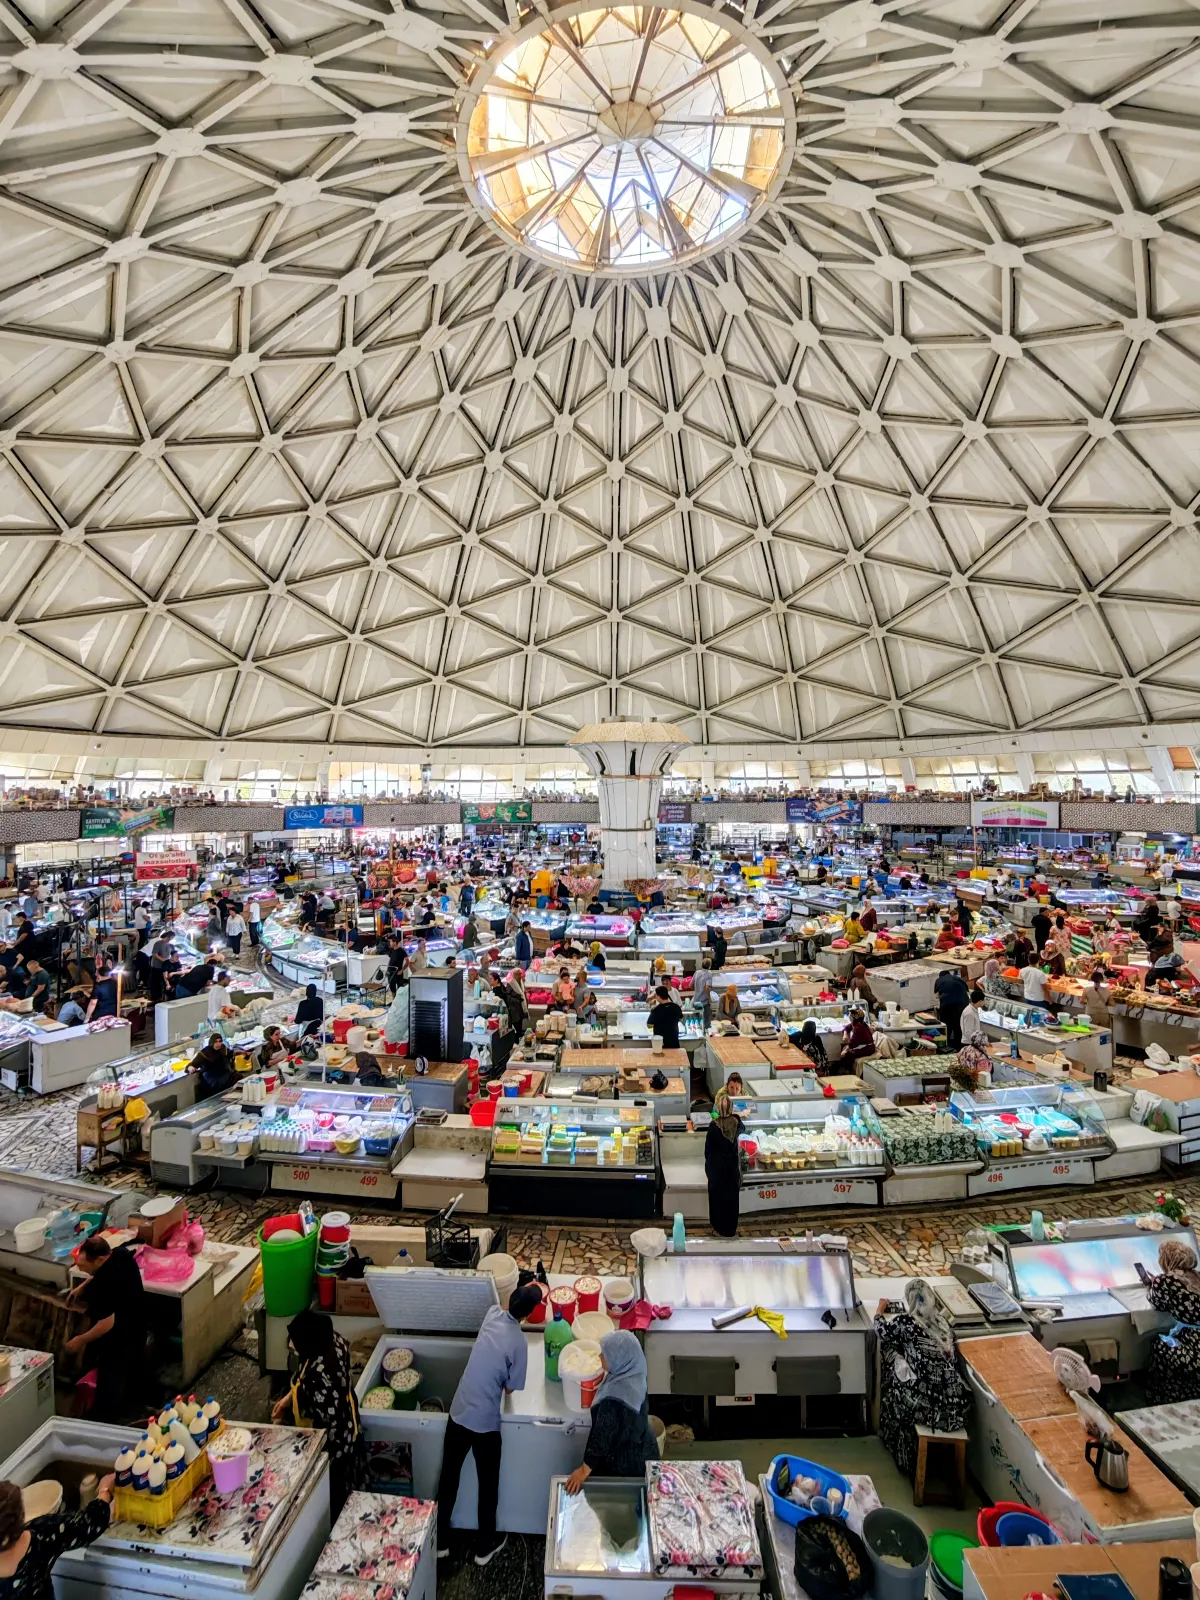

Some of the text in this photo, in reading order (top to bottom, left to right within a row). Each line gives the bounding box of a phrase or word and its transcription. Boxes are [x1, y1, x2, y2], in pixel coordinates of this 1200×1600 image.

[292, 1169, 310, 1181] 500
[1052, 1165, 1070, 1175] 495
[360, 1175, 378, 1186] 499
[987, 1173, 1003, 1183] 496
[833, 1183, 853, 1193] 497
[759, 1189, 777, 1199] 498
